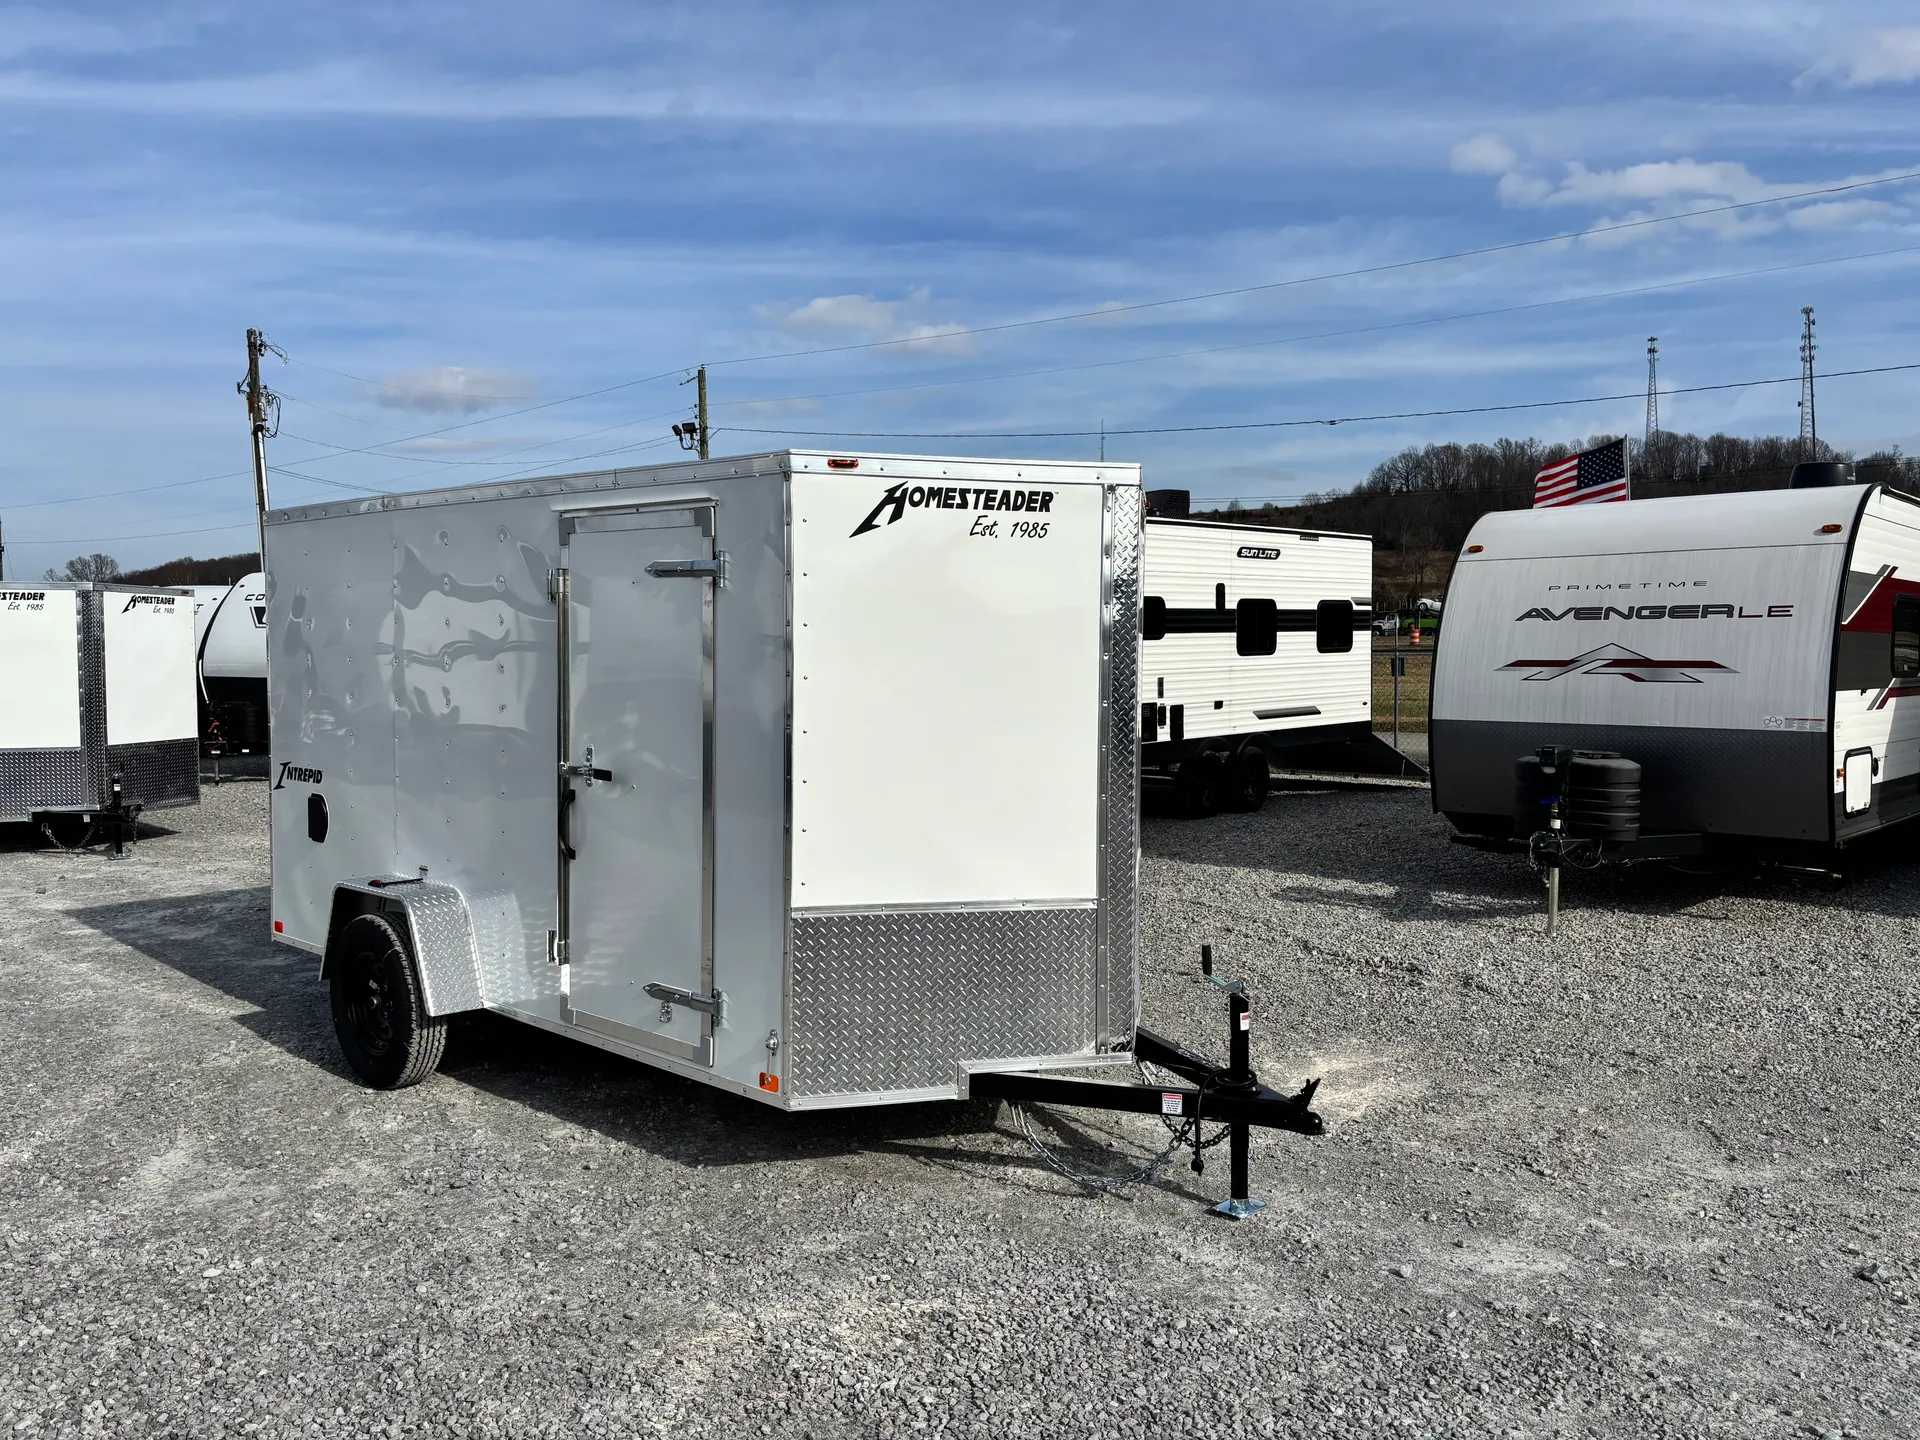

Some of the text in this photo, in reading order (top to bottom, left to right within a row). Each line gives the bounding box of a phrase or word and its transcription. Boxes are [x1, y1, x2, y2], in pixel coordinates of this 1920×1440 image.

[849, 481, 1054, 538] HOMESTEADER
[969, 515, 1050, 539] Est. 1985
[1240, 548, 1278, 558] SUN LITE
[0, 592, 45, 601] STEADER
[121, 594, 176, 614] HOMESTEADER
[26, 603, 44, 611] 1985
[272, 761, 323, 791] INTREPID
